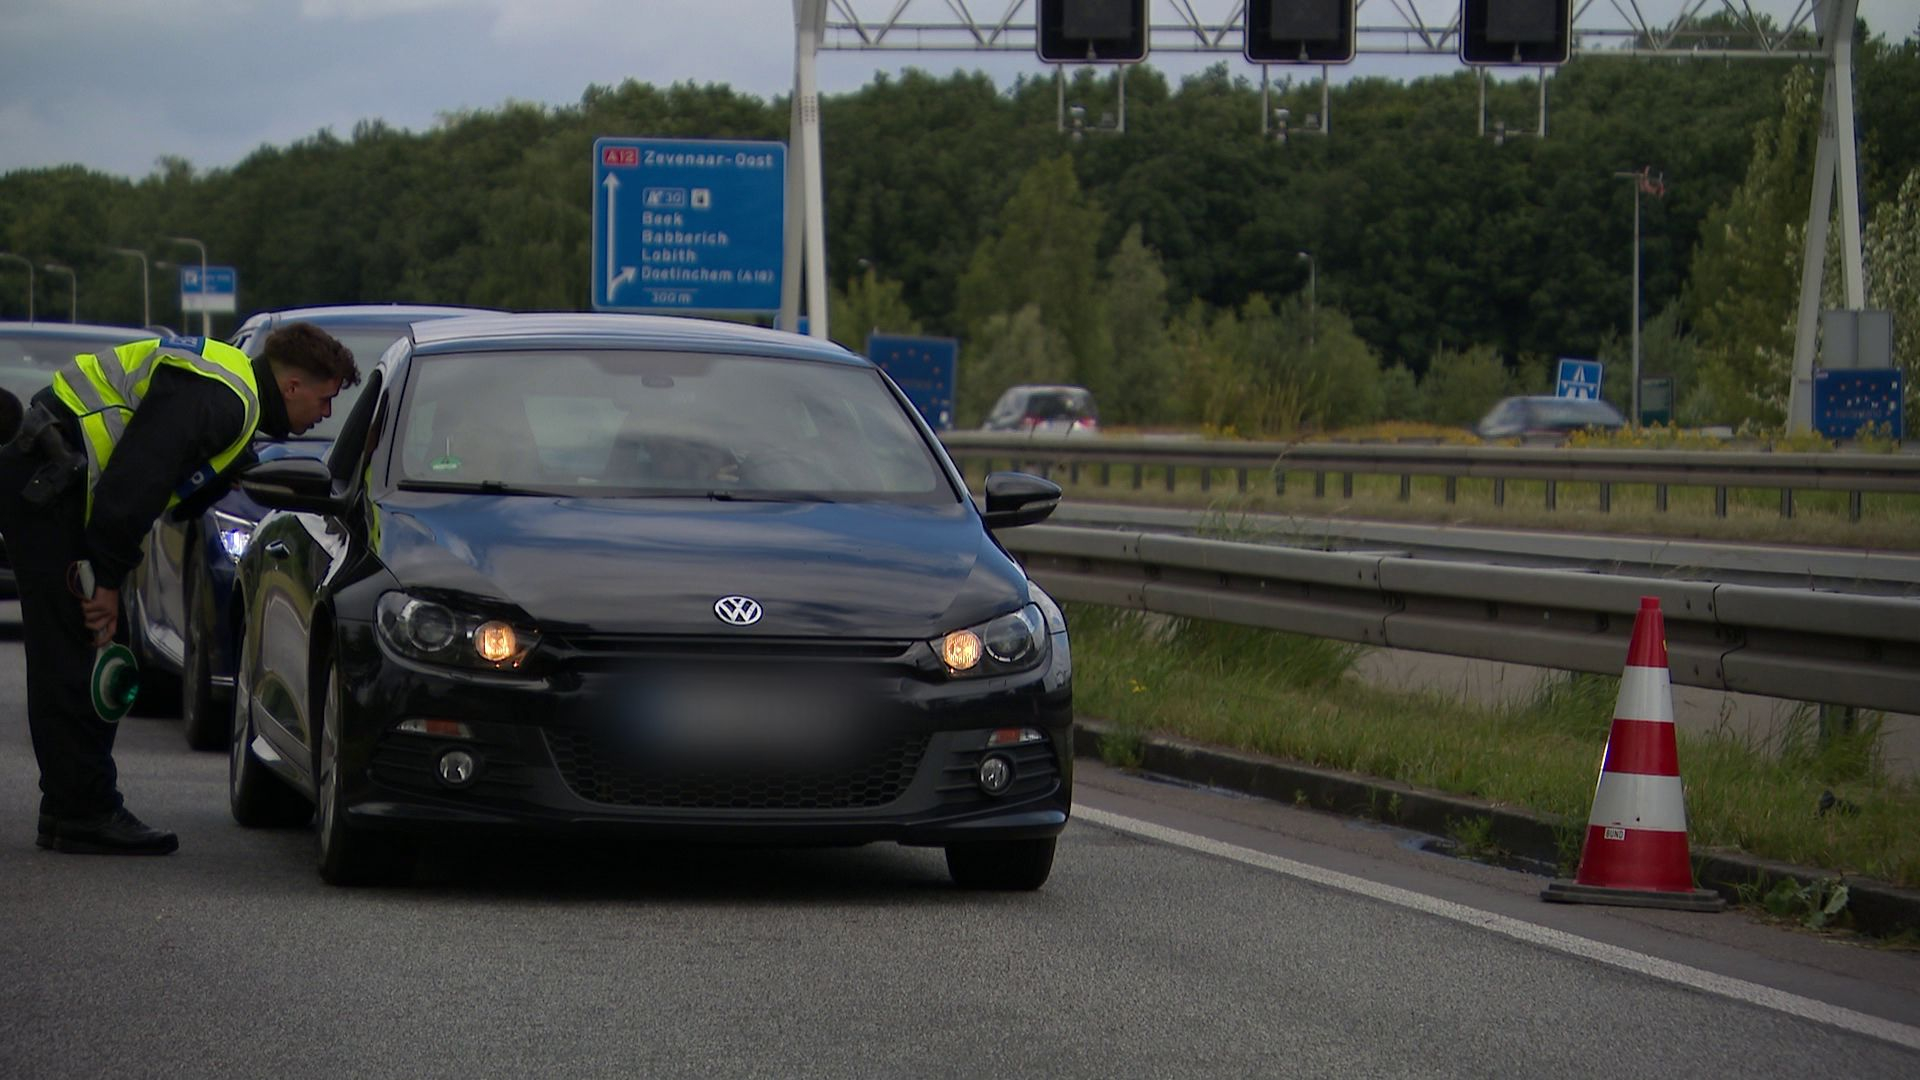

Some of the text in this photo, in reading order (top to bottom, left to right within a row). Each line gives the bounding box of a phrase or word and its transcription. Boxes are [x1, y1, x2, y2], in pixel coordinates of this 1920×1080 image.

[606, 150, 773, 167] A12 Zevenaar-Oost
[642, 211, 684, 226] Beek
[642, 229, 729, 245] Babberich
[641, 248, 697, 262] Lobith
[641, 266, 775, 285] Doetinchem (A18)
[714, 595, 762, 625] VW
[1605, 829, 1624, 839] BUND
